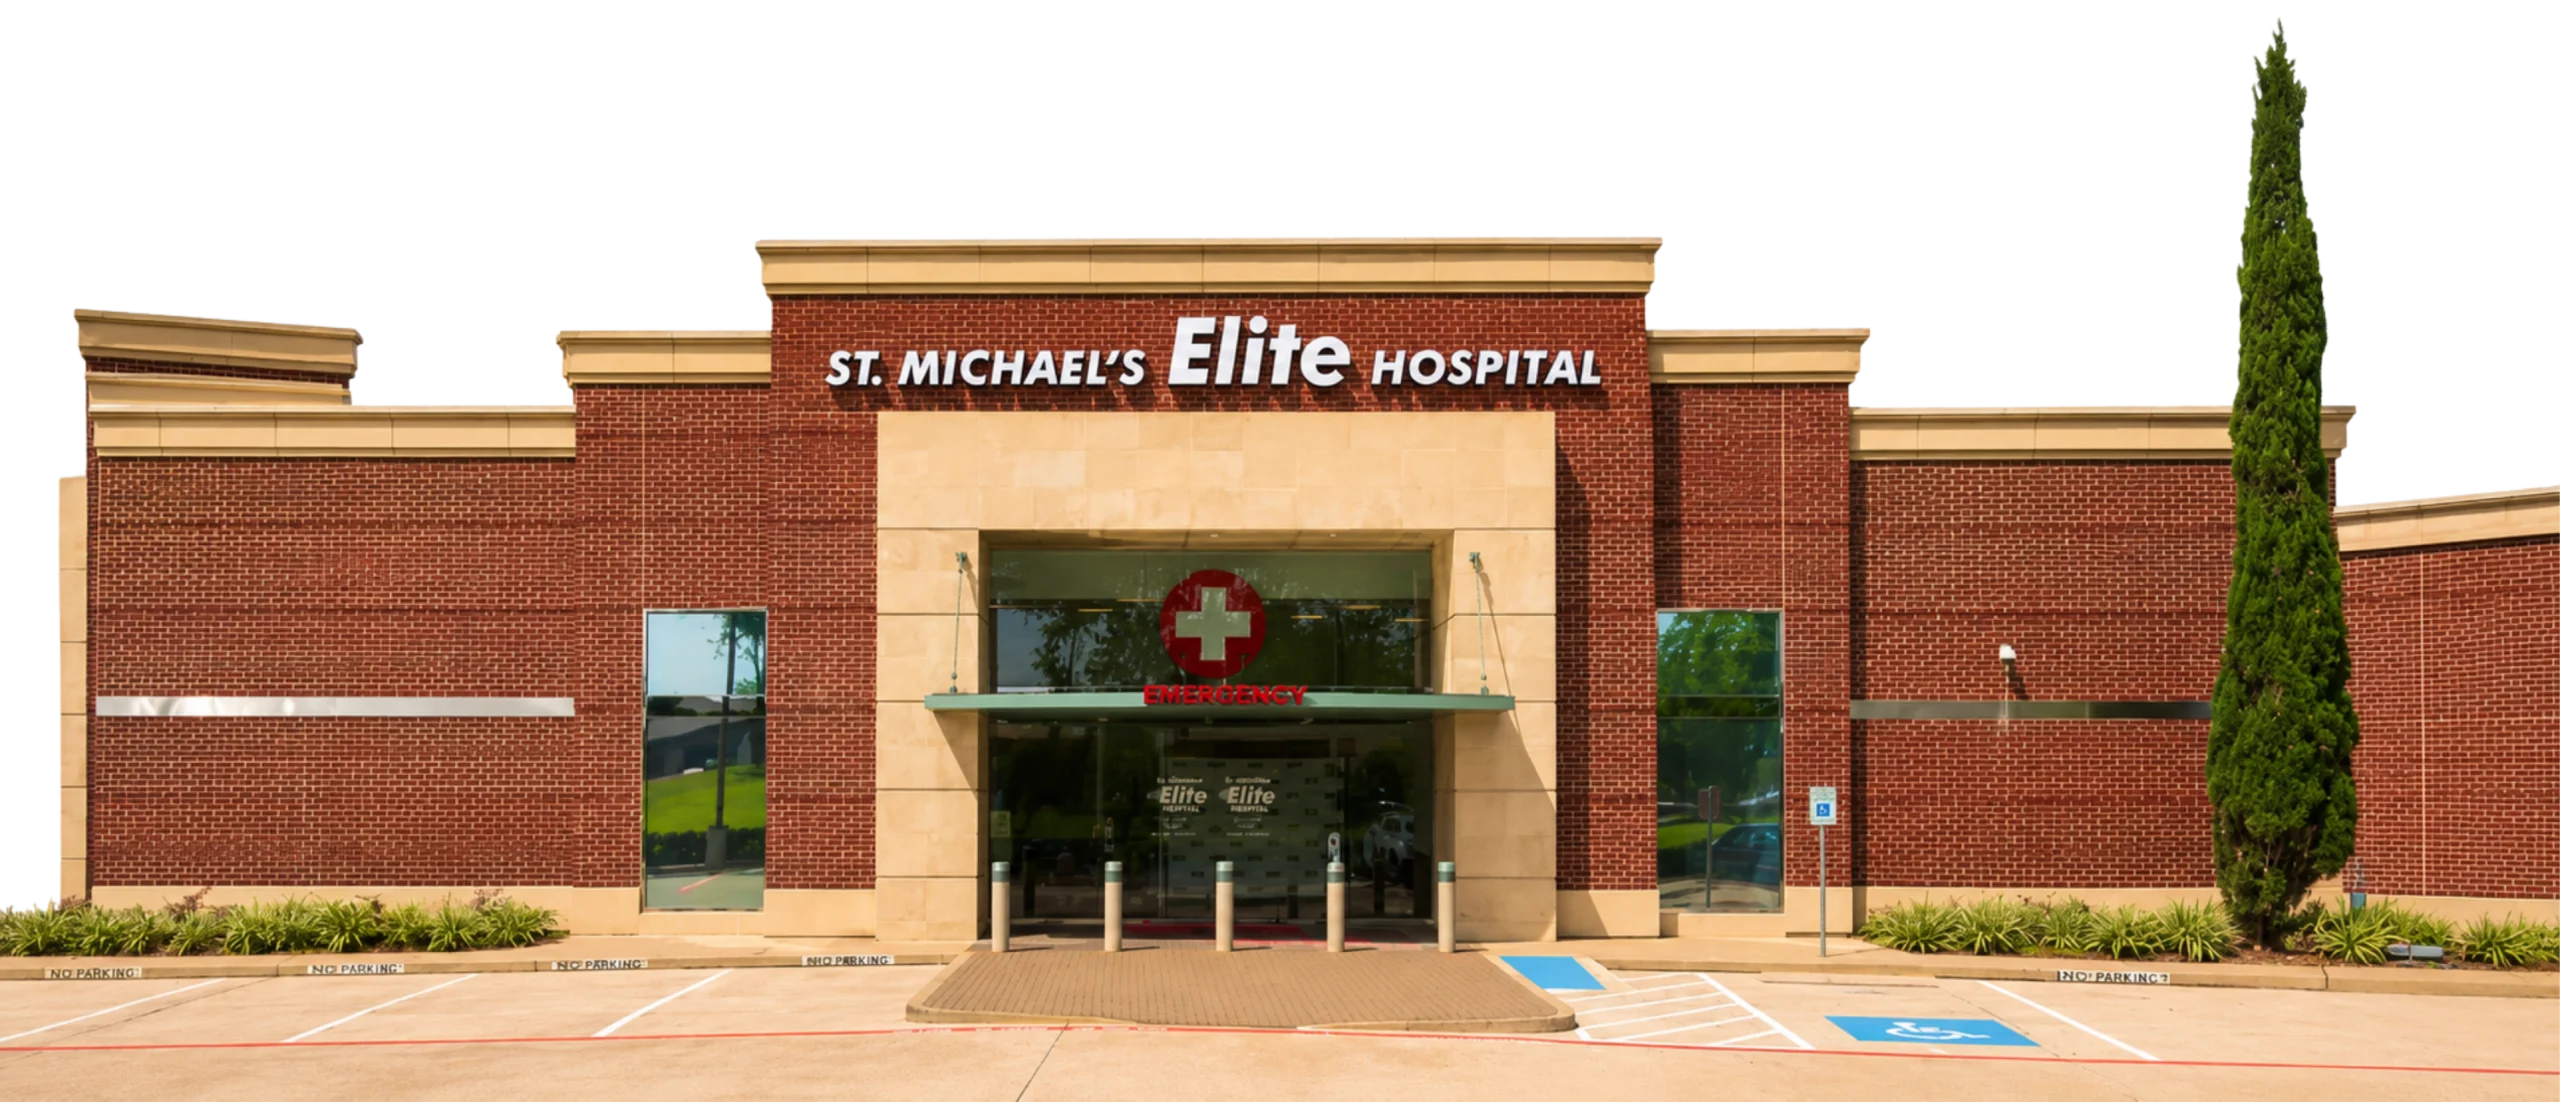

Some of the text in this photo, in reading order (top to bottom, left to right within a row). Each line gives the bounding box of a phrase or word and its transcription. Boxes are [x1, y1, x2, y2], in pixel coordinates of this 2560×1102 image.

[825, 315, 1601, 387] ST. MICHAEL'S Elite HOSPITAL
[1143, 684, 1308, 705] EMERGENCY
[1159, 785, 1207, 804] Elite
[1227, 785, 1276, 804] Elite
[585, 959, 641, 970] PARKING
[835, 956, 888, 965] PARKING
[50, 968, 134, 979] NO PARKING
[341, 964, 397, 974] PARKING
